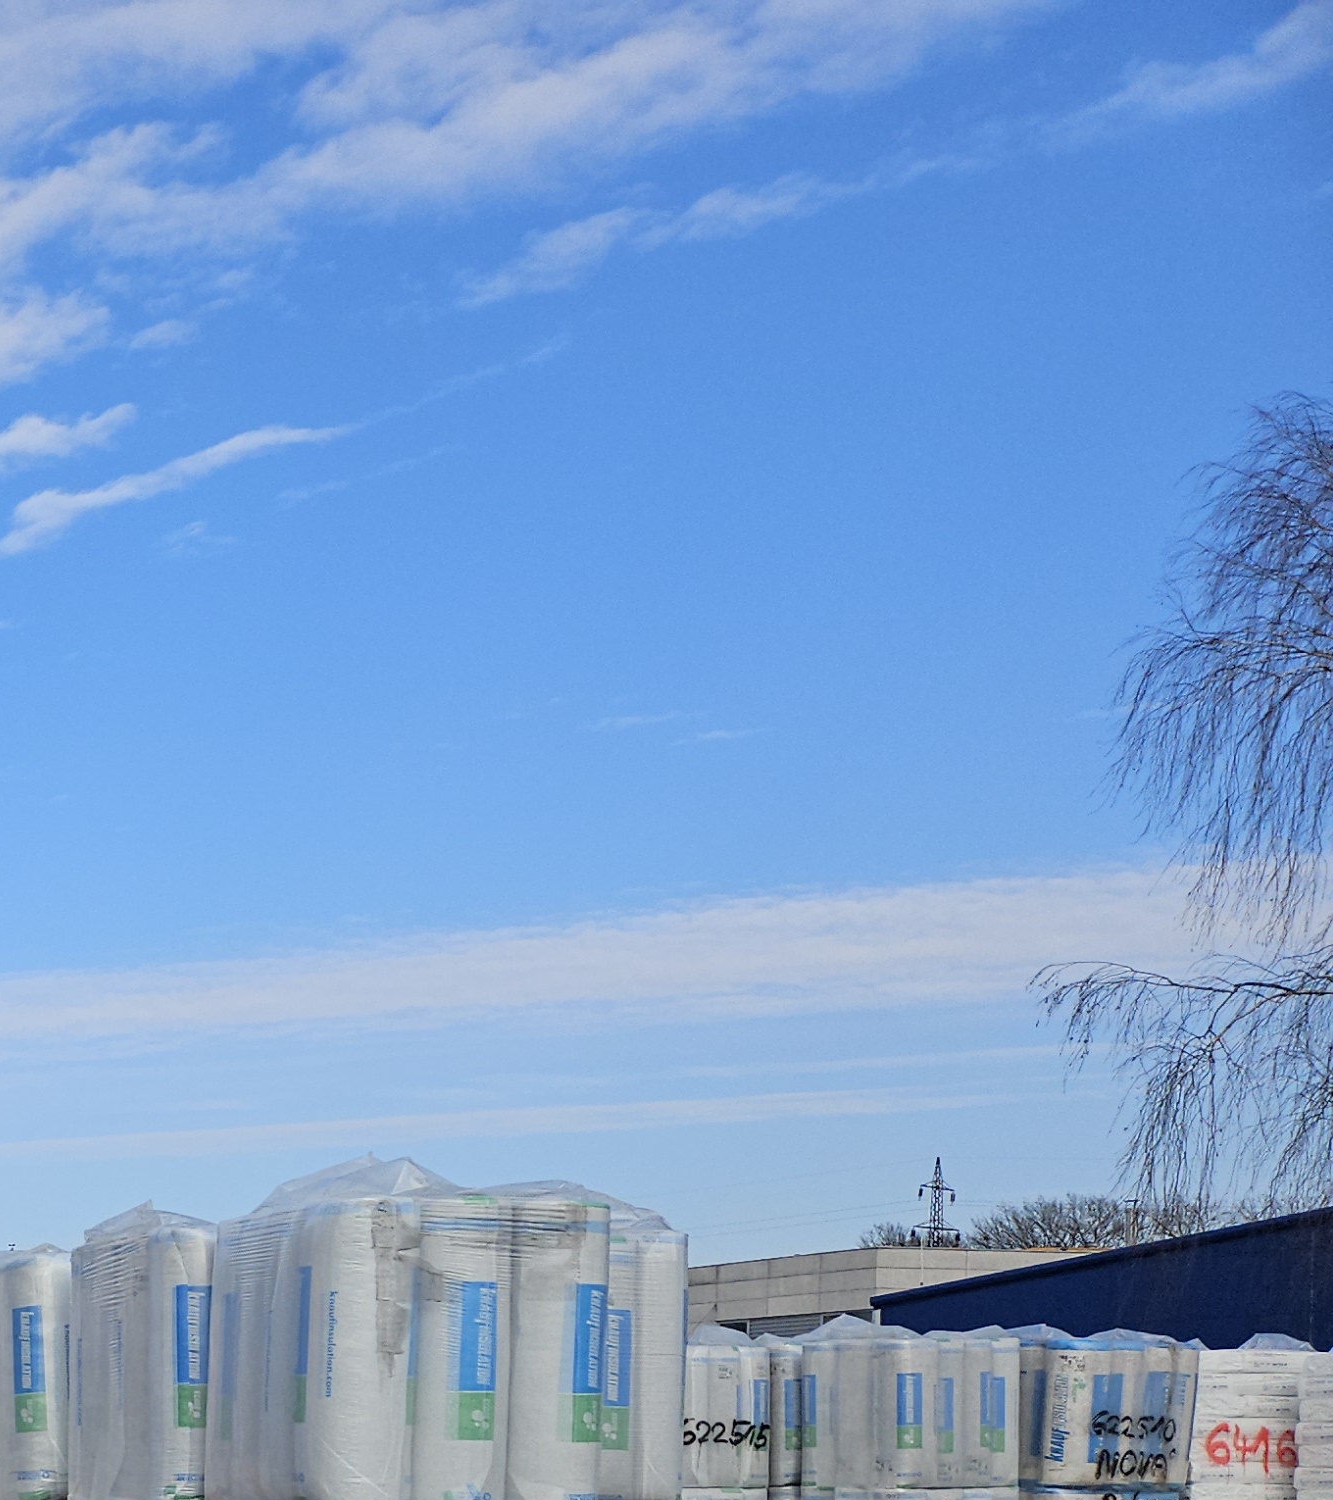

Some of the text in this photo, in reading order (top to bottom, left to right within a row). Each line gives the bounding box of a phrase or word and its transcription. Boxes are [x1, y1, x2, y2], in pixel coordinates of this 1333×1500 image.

[326, 1290, 338, 1398] knaufinsulation.com
[1044, 1427, 1070, 1463] KNAUF
[1205, 1422, 1299, 1475] 6416
